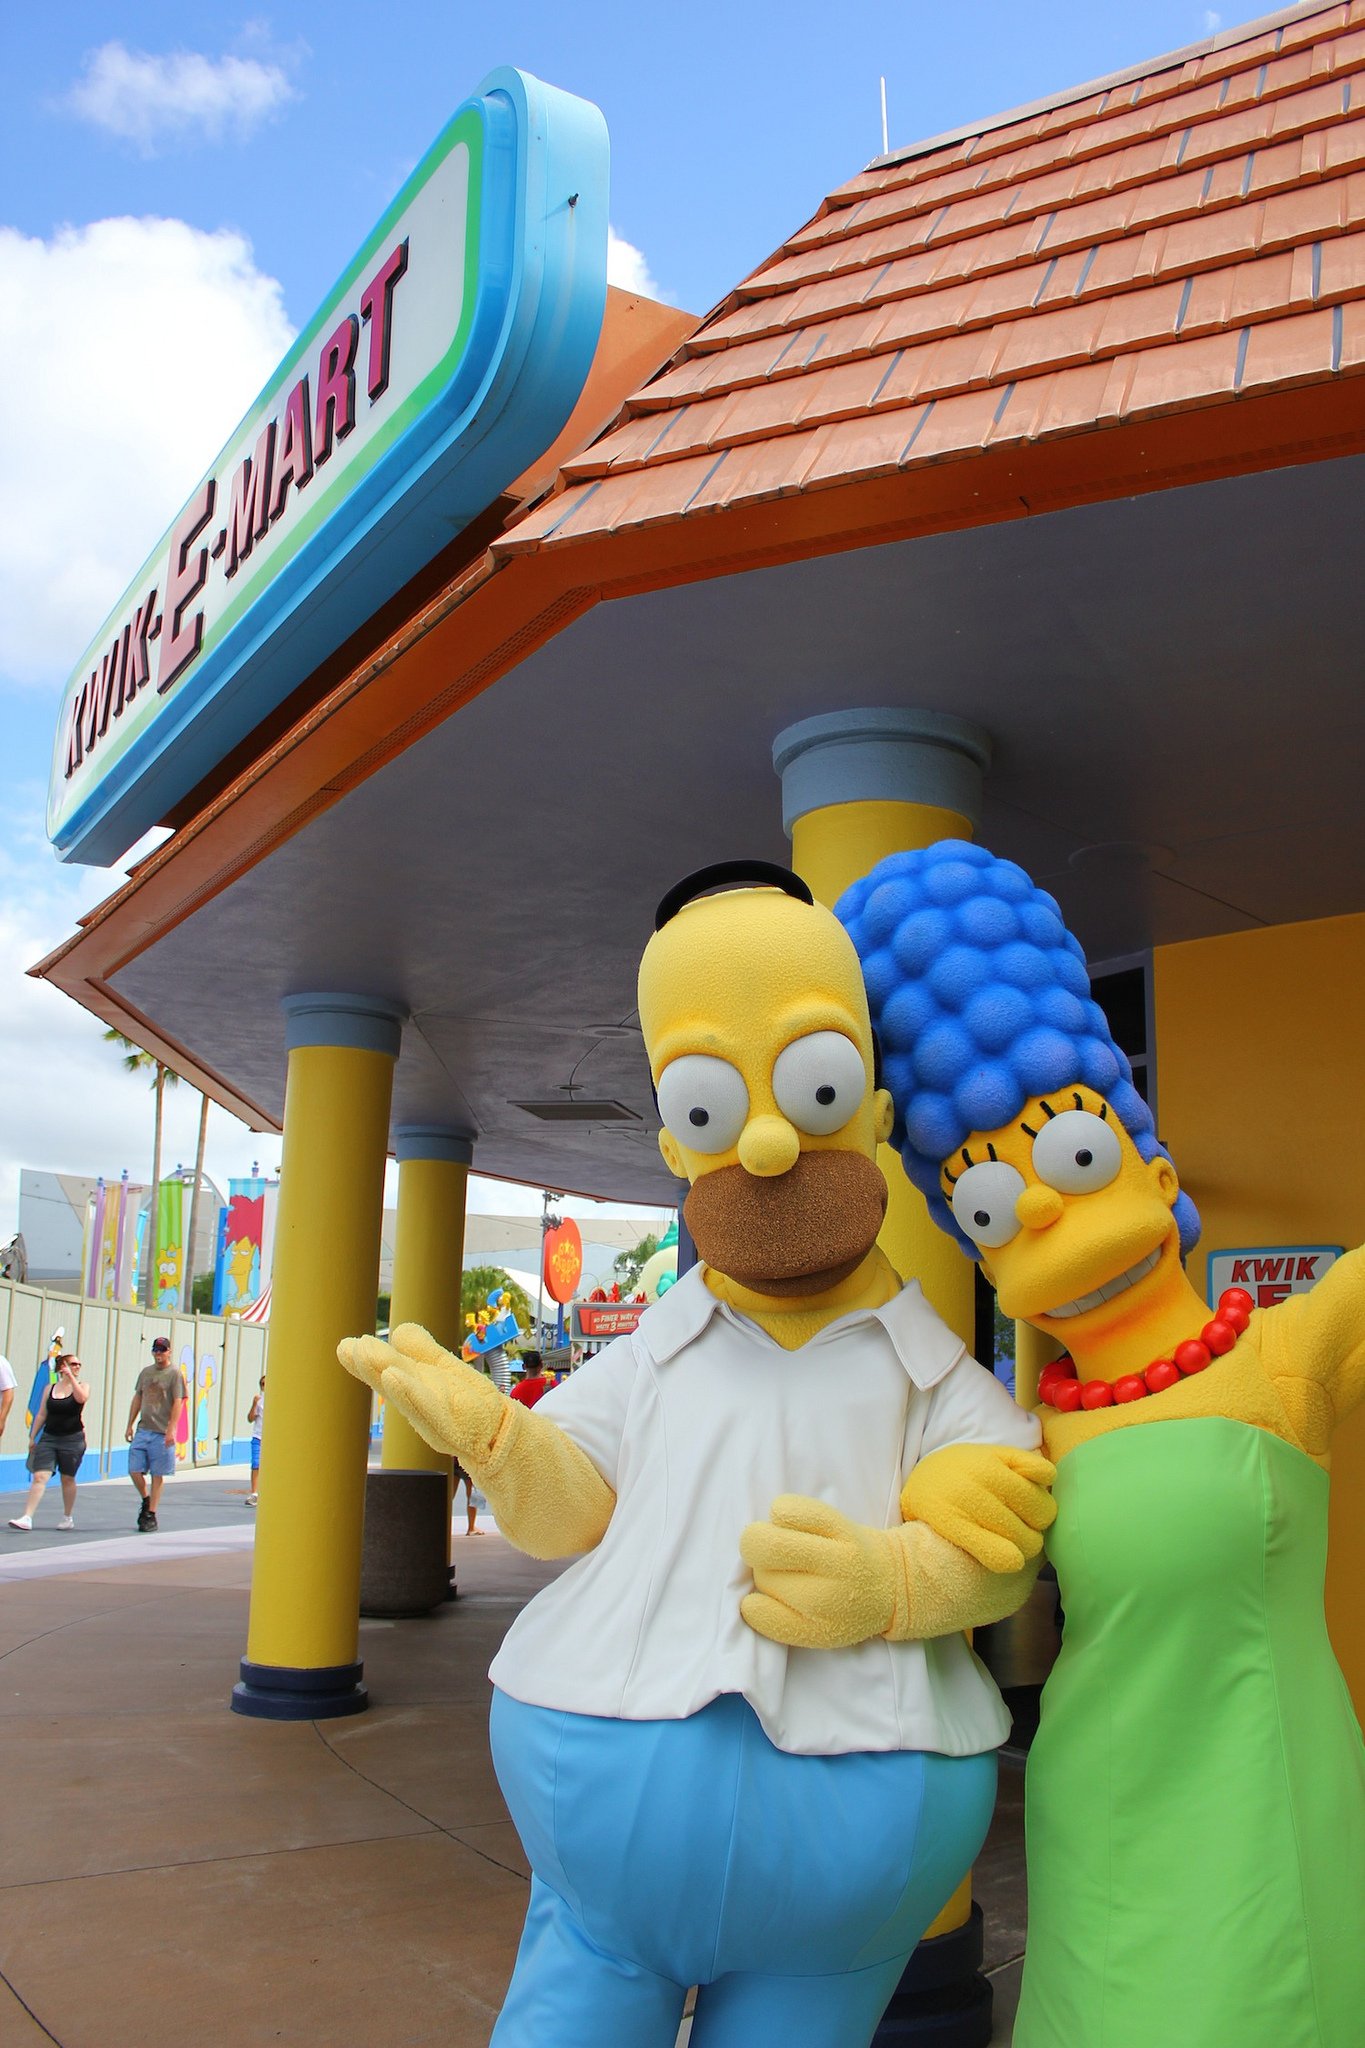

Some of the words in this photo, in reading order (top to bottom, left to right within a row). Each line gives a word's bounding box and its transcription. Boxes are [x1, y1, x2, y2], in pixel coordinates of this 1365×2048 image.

[64, 236, 410, 780] KWIK-E-MART
[1231, 1256, 1320, 1283] KWIK
[610, 1321, 617, 1332] 3
